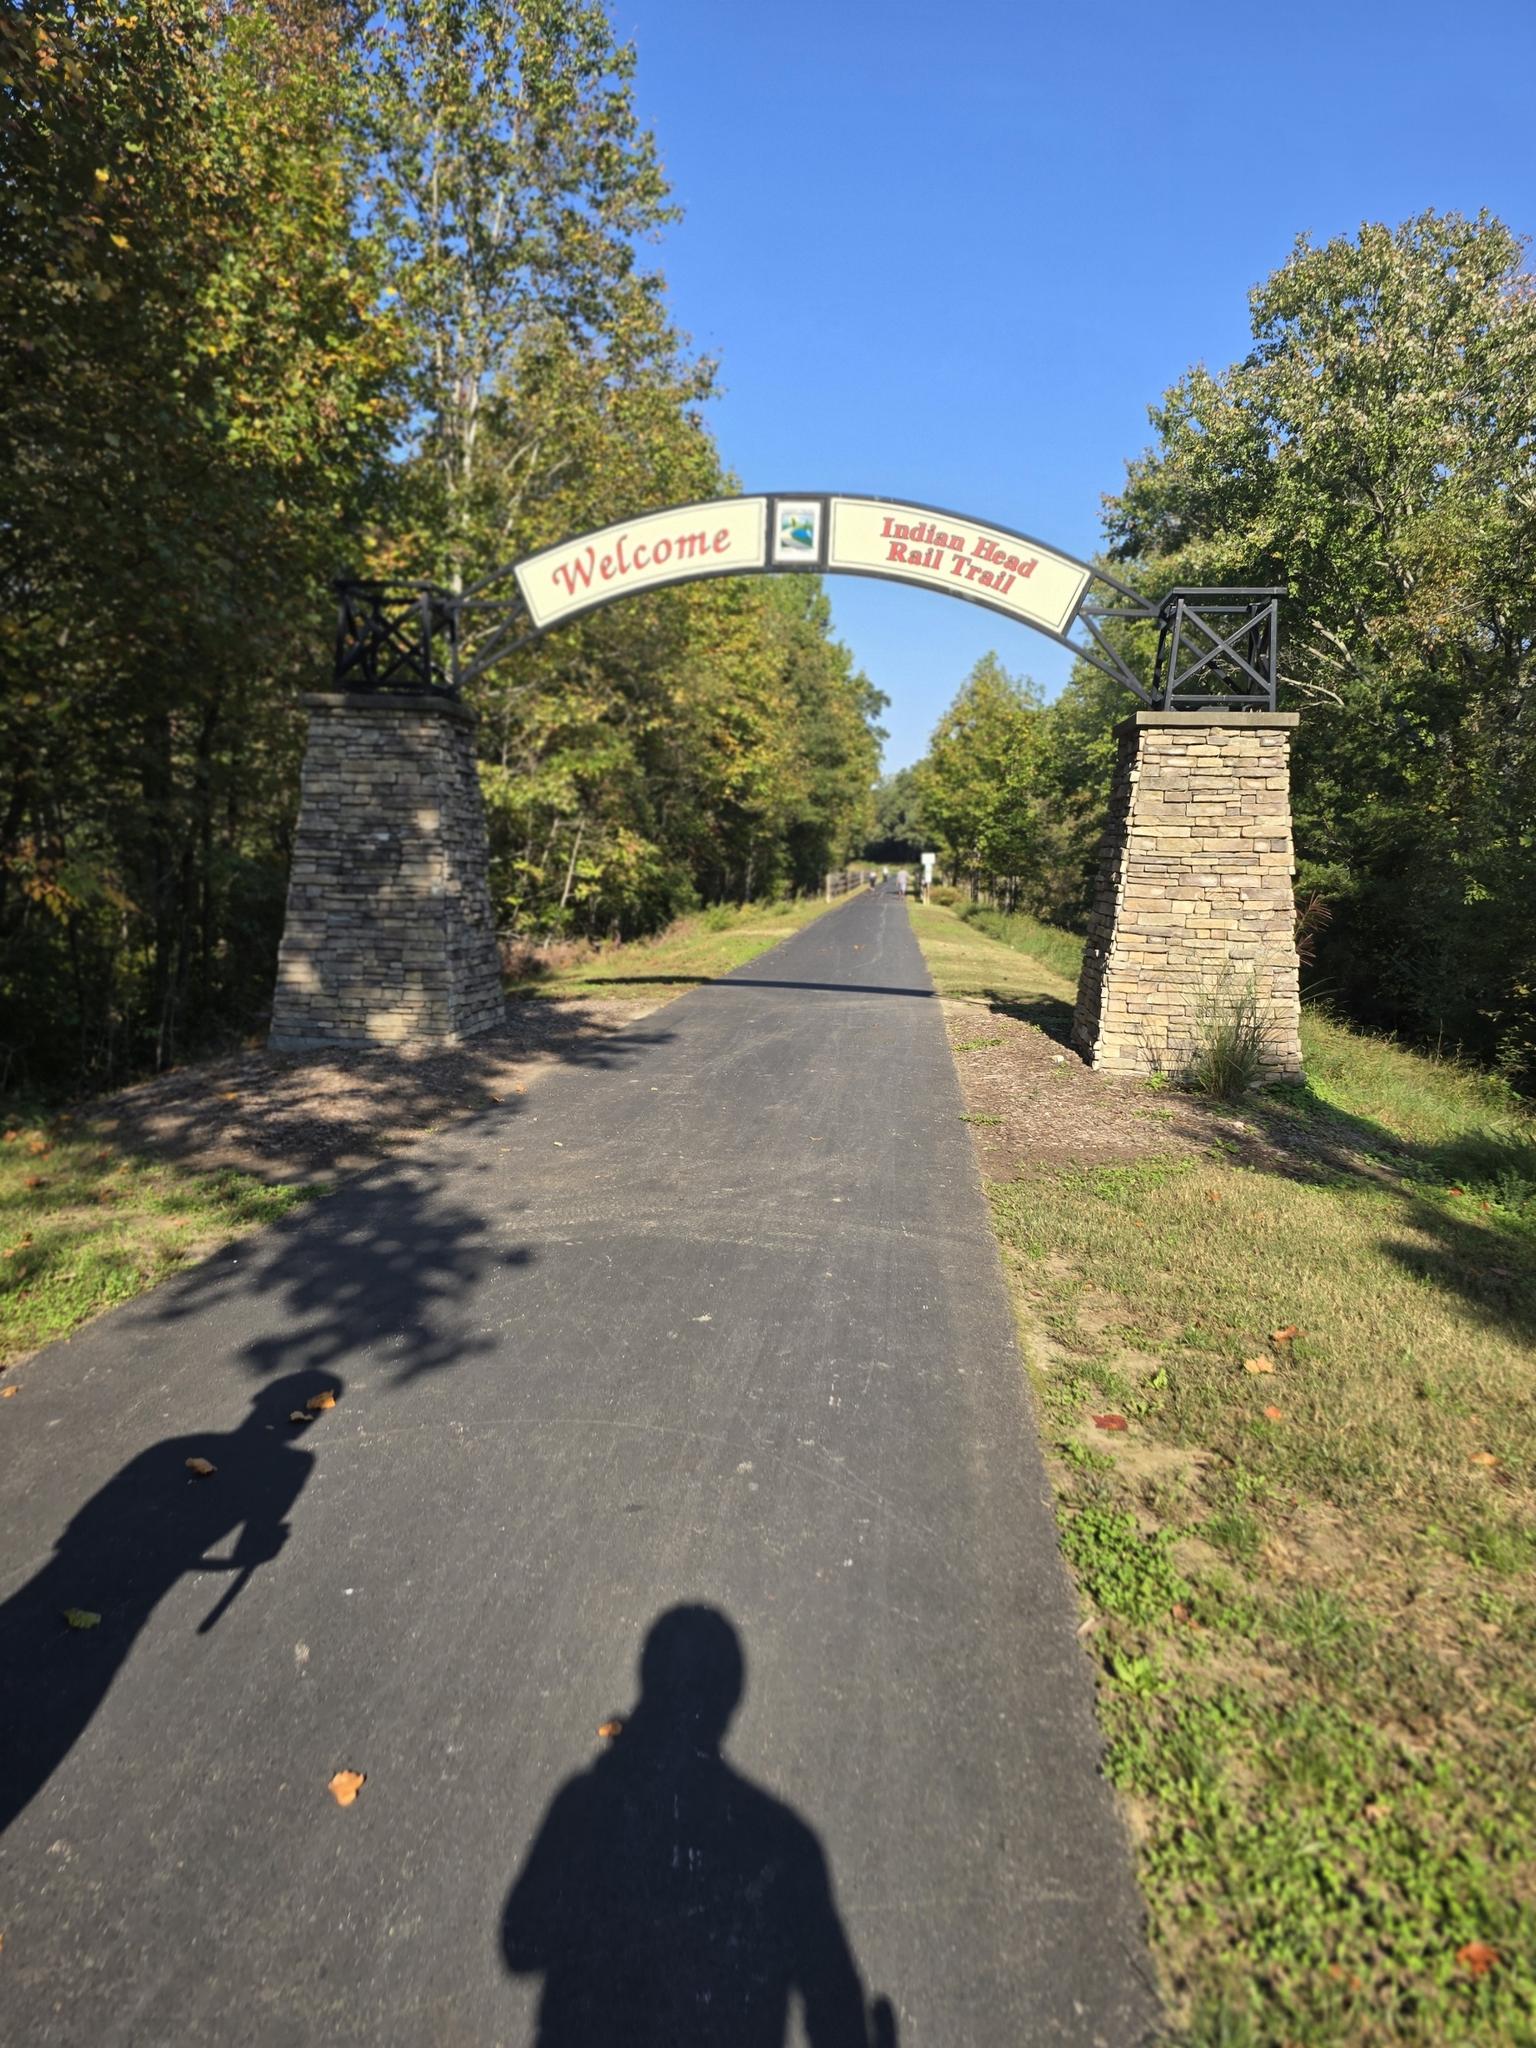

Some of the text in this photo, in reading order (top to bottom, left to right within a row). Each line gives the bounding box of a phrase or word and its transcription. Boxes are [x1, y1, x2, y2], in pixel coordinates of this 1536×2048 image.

[552, 528, 732, 596] Welcome
[880, 517, 1039, 579] Indian Head
[886, 541, 1017, 594] Rail Trail
